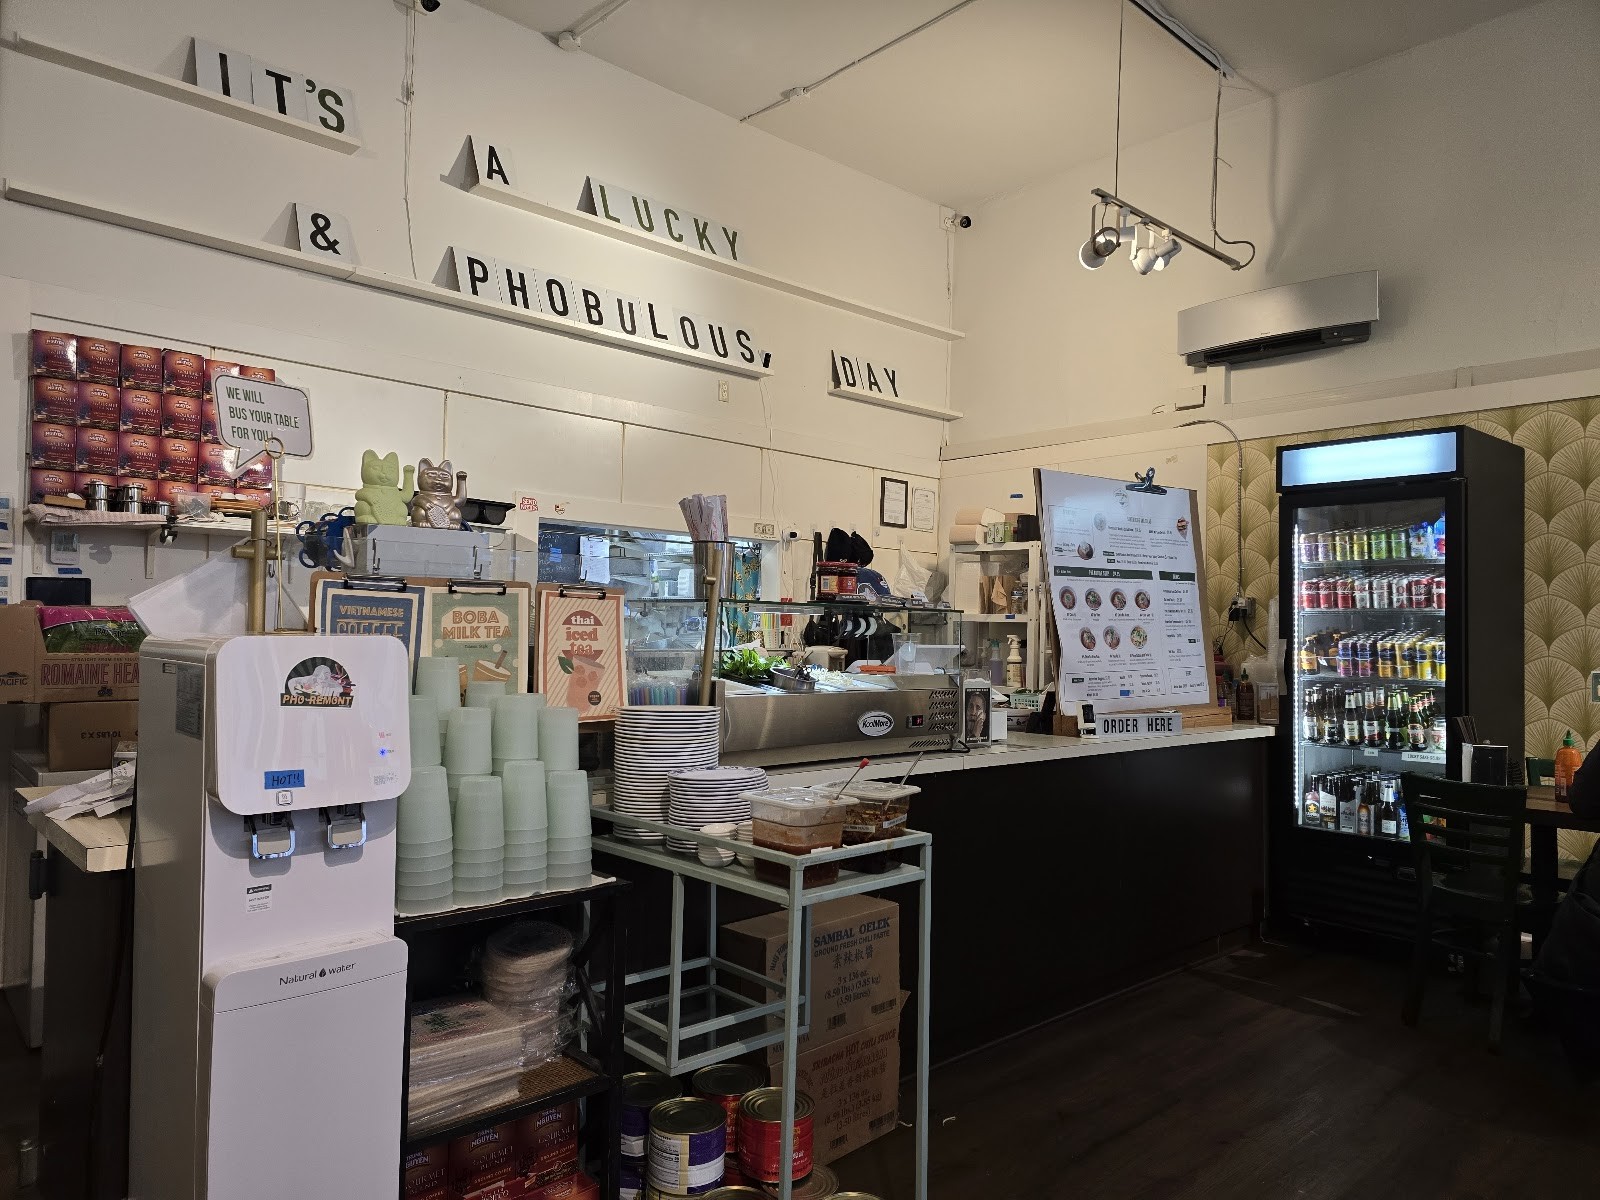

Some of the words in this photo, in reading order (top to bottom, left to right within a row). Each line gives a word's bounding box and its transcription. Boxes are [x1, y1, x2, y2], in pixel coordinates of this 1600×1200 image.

[217, 51, 347, 134] IT'S
[485, 144, 511, 185] A
[598, 183, 742, 261] LUCKY
[309, 212, 342, 255] &
[840, 355, 899, 398] DAY
[226, 386, 242, 401] WE
[242, 388, 265, 405] WILL
[228, 406, 248, 421] BUS
[249, 408, 273, 425] YOUR
[274, 412, 300, 429] TABLE
[231, 426, 250, 439] FOR
[339, 604, 404, 618] VIETNAMESE
[452, 610, 500, 624] BOBA
[570, 614, 595, 625] thai
[442, 625, 482, 640] MILK
[484, 624, 513, 639] TEA
[565, 626, 599, 642] iced
[569, 641, 595, 656] tea
[41, 663, 109, 686] ROMAINE
[1103, 718, 1139, 734] ORDER
[1147, 717, 1173, 732] HERE
[272, 772, 300, 786] HOT!!
[813, 928, 856, 948] SAMBAL
[859, 917, 891, 934] OELEK
[814, 946, 839, 958] GROUND
[839, 940, 858, 951] FRESH
[858, 935, 873, 945] CHILI
[873, 930, 890, 941] PASTE
[279, 970, 318, 986] Natural
[328, 962, 357, 975] water
[845, 1041, 860, 1058] HOT
[536, 1113, 562, 1128] NGUYEN
[471, 1132, 499, 1147] NGUYEN
[405, 1155, 430, 1169] GUYEN
